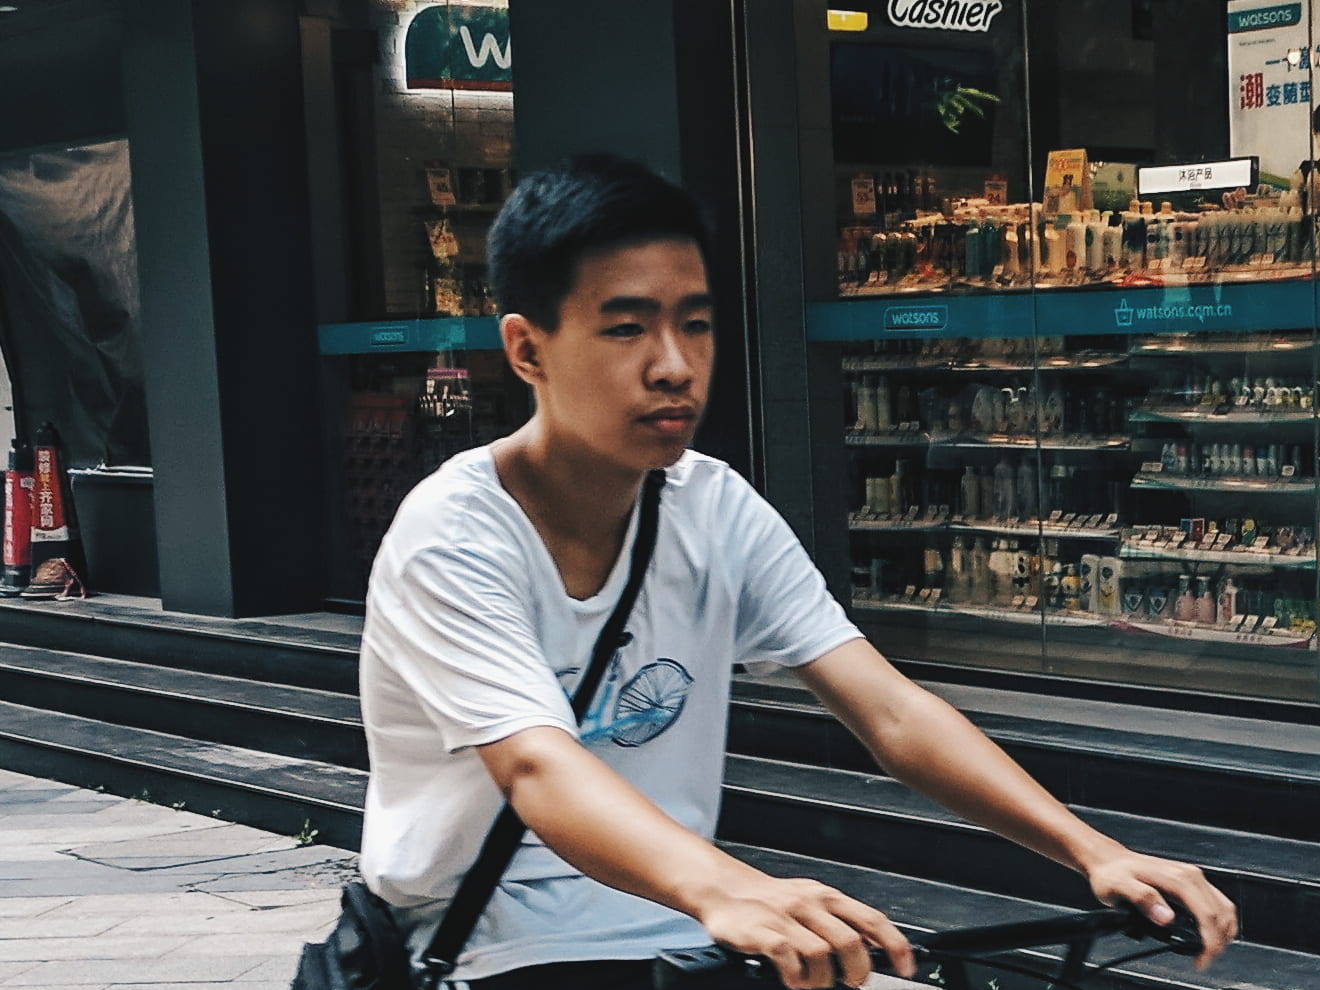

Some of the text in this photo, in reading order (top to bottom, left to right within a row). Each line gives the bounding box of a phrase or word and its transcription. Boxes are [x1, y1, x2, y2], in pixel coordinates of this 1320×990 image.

[1239, 9, 1292, 27] watsons
[1240, 72, 1264, 110] 潮
[891, 311, 939, 326] watsons
[1136, 303, 1232, 321] watsons.com.cn
